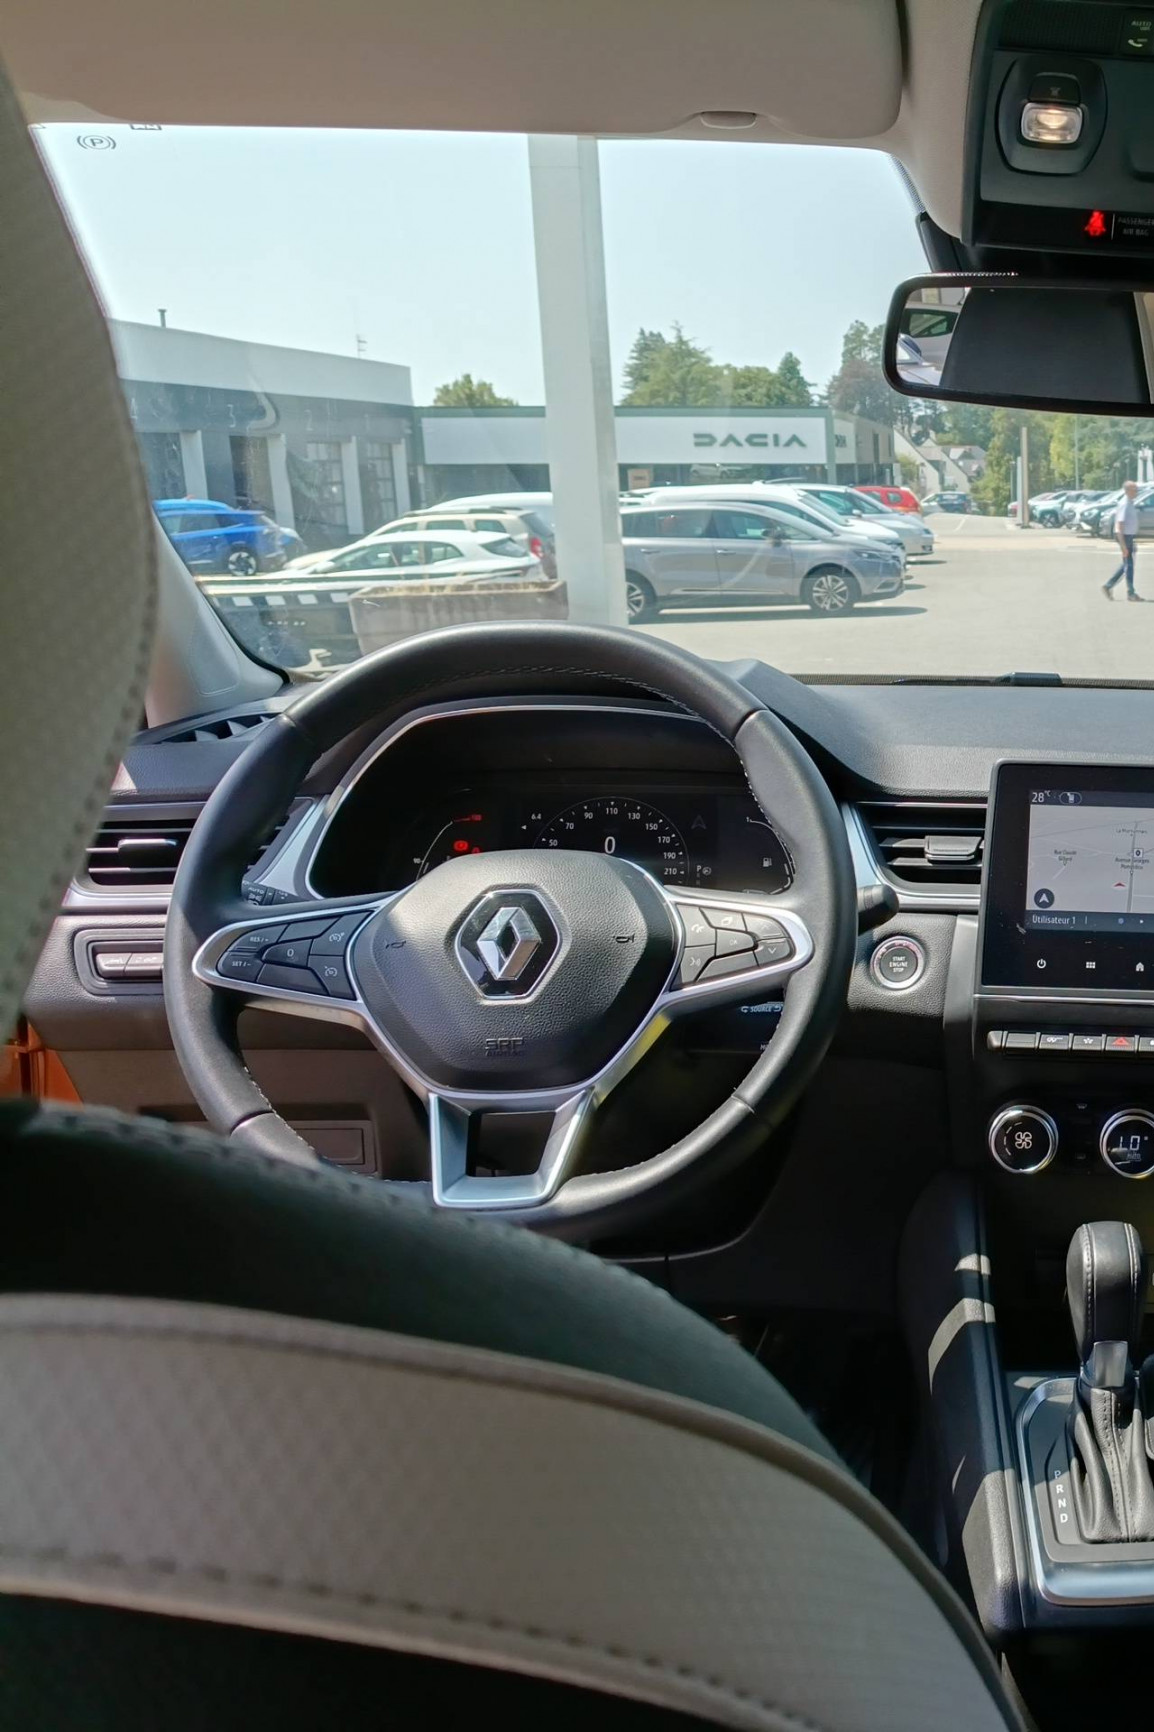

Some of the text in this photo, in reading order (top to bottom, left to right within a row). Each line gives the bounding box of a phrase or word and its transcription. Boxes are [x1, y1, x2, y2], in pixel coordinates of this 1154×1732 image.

[227, 404, 236, 428] 3
[693, 432, 807, 449] DACIA
[605, 807, 618, 815] 110
[584, 812, 593, 820] 90
[628, 812, 641, 820] 130
[565, 822, 575, 830] 70
[645, 823, 658, 831] 150
[549, 839, 558, 847] 50
[604, 836, 616, 854] 0
[1032, 914, 1070, 924] Utilisateur
[1054, 1470, 1061, 1479] P
[1055, 1484, 1064, 1494] R
[1058, 1498, 1067, 1508] N
[1060, 1513, 1068, 1523] D
